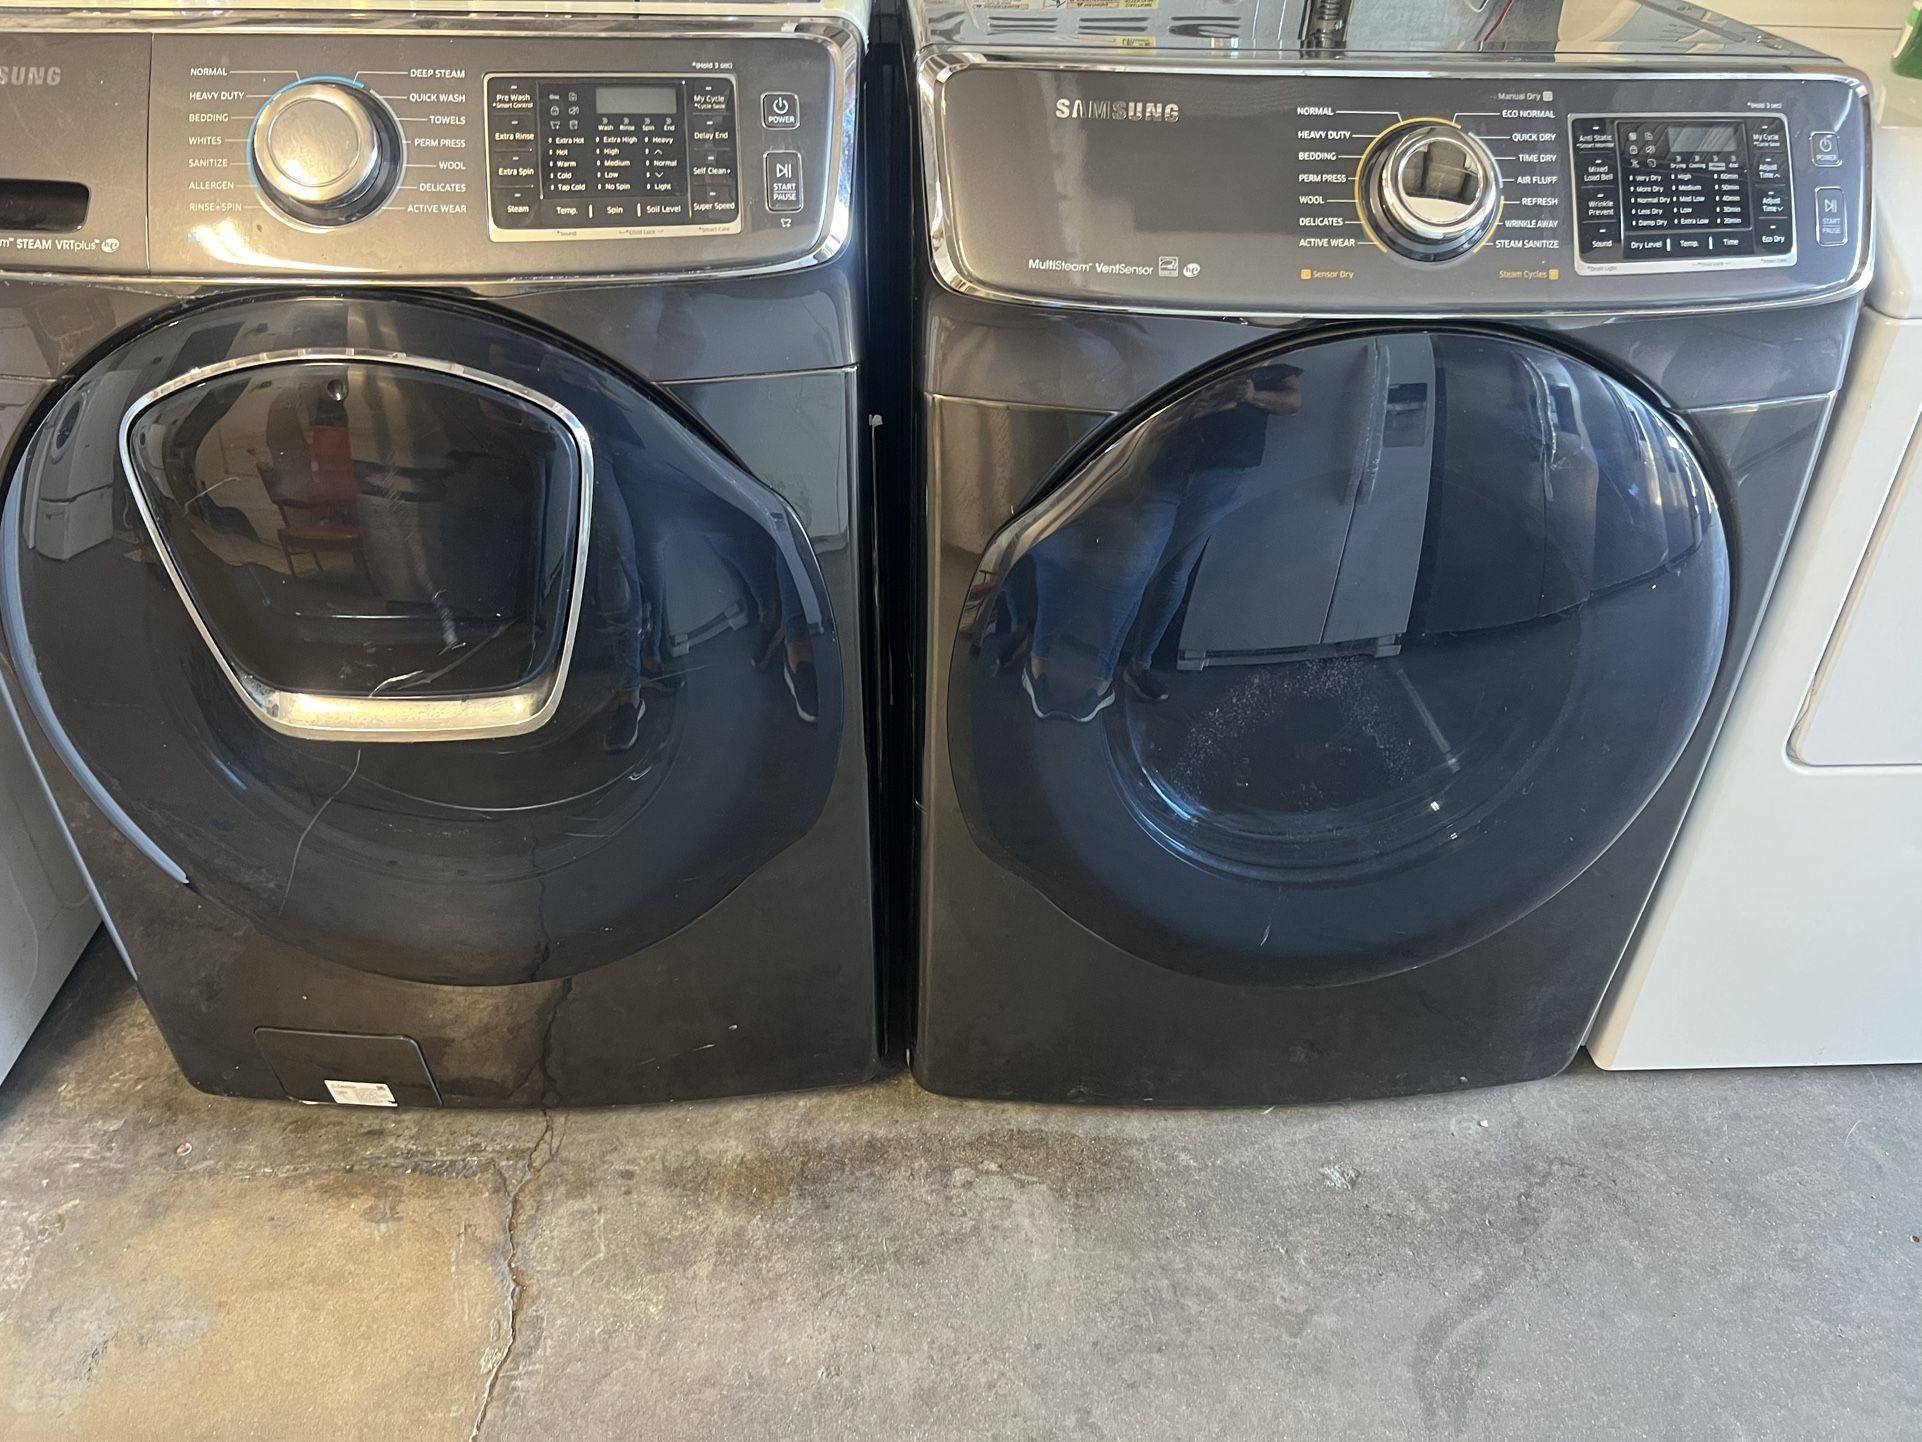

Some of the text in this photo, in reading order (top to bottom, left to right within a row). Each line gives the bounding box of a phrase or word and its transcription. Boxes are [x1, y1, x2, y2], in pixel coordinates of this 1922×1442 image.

[190, 67, 228, 77] NORMAL
[410, 69, 466, 79] DEEP STEAM
[189, 91, 244, 100] HEAVY DUTY
[409, 93, 466, 103] QUICK WASH
[496, 94, 509, 102] Pre
[694, 95, 725, 103] My Cycle
[1499, 92, 1541, 102] Manual Dry
[1056, 99, 1179, 122] SAMSUNG
[1297, 107, 1334, 116] NORMAL
[1502, 110, 1556, 119] ECO NORMAL
[189, 113, 229, 122] BEDDING
[430, 115, 466, 125] TOWELS
[769, 116, 795, 124] POWER
[495, 133, 535, 141] Extra Rinse
[694, 132, 714, 140] Delay
[1298, 131, 1351, 139] HEAVY DUTY
[1512, 133, 1556, 142] QUICK DRY
[188, 136, 222, 145] WHITES
[415, 138, 466, 148] PERM PRESS
[622, 136, 638, 144] High
[653, 137, 674, 145] Heavy
[604, 148, 620, 156] High
[1299, 153, 1337, 161] BEDDING
[1519, 154, 1557, 163] TIME DRY
[188, 158, 228, 168] SANITIZE
[439, 161, 466, 170] WOOL
[499, 168, 534, 176] Extra Spin
[693, 167, 707, 175] Self
[1299, 174, 1347, 183] PERM PRESS
[1517, 176, 1558, 184] AIR FLUFF
[188, 181, 234, 190] ALLERGEN
[419, 183, 466, 192] DELICATES
[616, 183, 631, 191] Spin
[655, 183, 672, 191] Light
[774, 183, 797, 191] START
[1299, 196, 1325, 205] WOOL
[1522, 198, 1558, 206] REFRESH
[1588, 200, 1614, 208] Wrinkle
[189, 202, 242, 212] RINSE+SPIN
[407, 204, 467, 213] ACTIVE WEAR
[507, 205, 529, 213] Steam
[556, 207, 578, 215] Temp.
[607, 206, 624, 215] Spin
[647, 205, 681, 213] Soil Level
[694, 202, 735, 211] Super Speed
[1299, 218, 1344, 226] DELICATES
[1505, 220, 1558, 228] WRINKLE AWAY
[1657, 219, 1668, 227] Dry
[17, 239, 52, 250] STEAM
[1299, 239, 1355, 247] ACTIVE WEAR
[1496, 240, 1559, 249] STEAM SANITIZE
[1631, 241, 1662, 250] Dry Level
[1096, 262, 1154, 275] VentSensor
[1313, 270, 1354, 280] Sensor Dry
[1500, 271, 1547, 280] Steam Cycles
